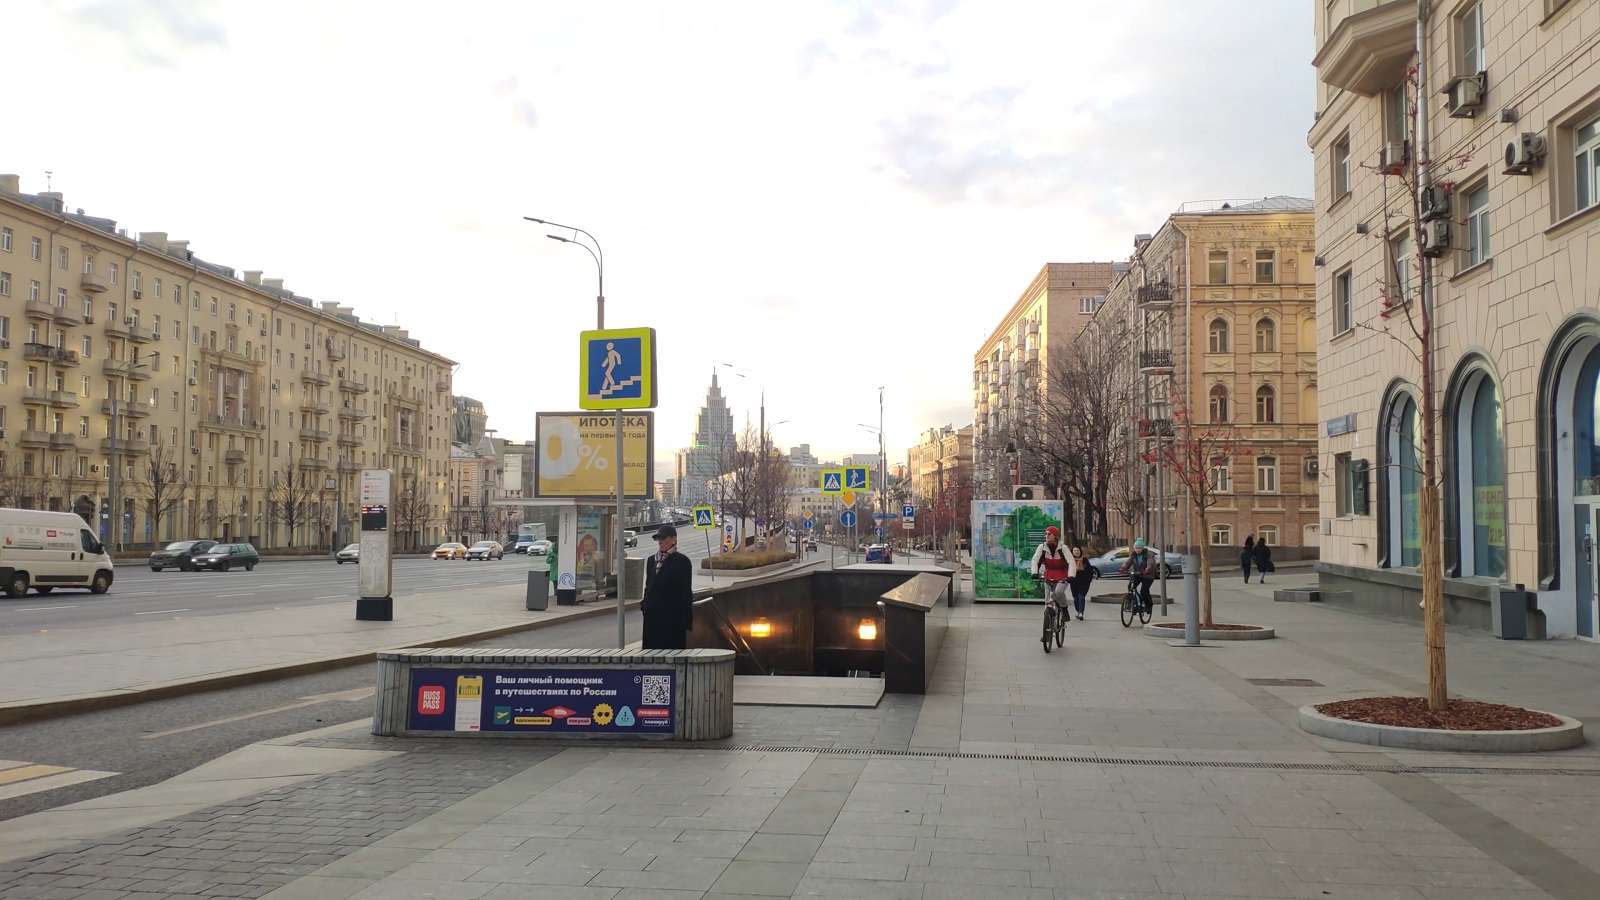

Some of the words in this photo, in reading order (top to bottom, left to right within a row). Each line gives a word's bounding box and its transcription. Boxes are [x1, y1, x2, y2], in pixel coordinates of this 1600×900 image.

[579, 417, 646, 427] ИПОТЕКА
[905, 507, 913, 517] P
[496, 675, 516, 684] Ваш
[517, 675, 553, 684] личный
[554, 677, 604, 685] помощник
[423, 690, 441, 700] RUSS
[495, 688, 501, 696] в
[502, 688, 569, 698] путешествиях
[583, 687, 617, 696] России
[422, 700, 440, 710] PASS
